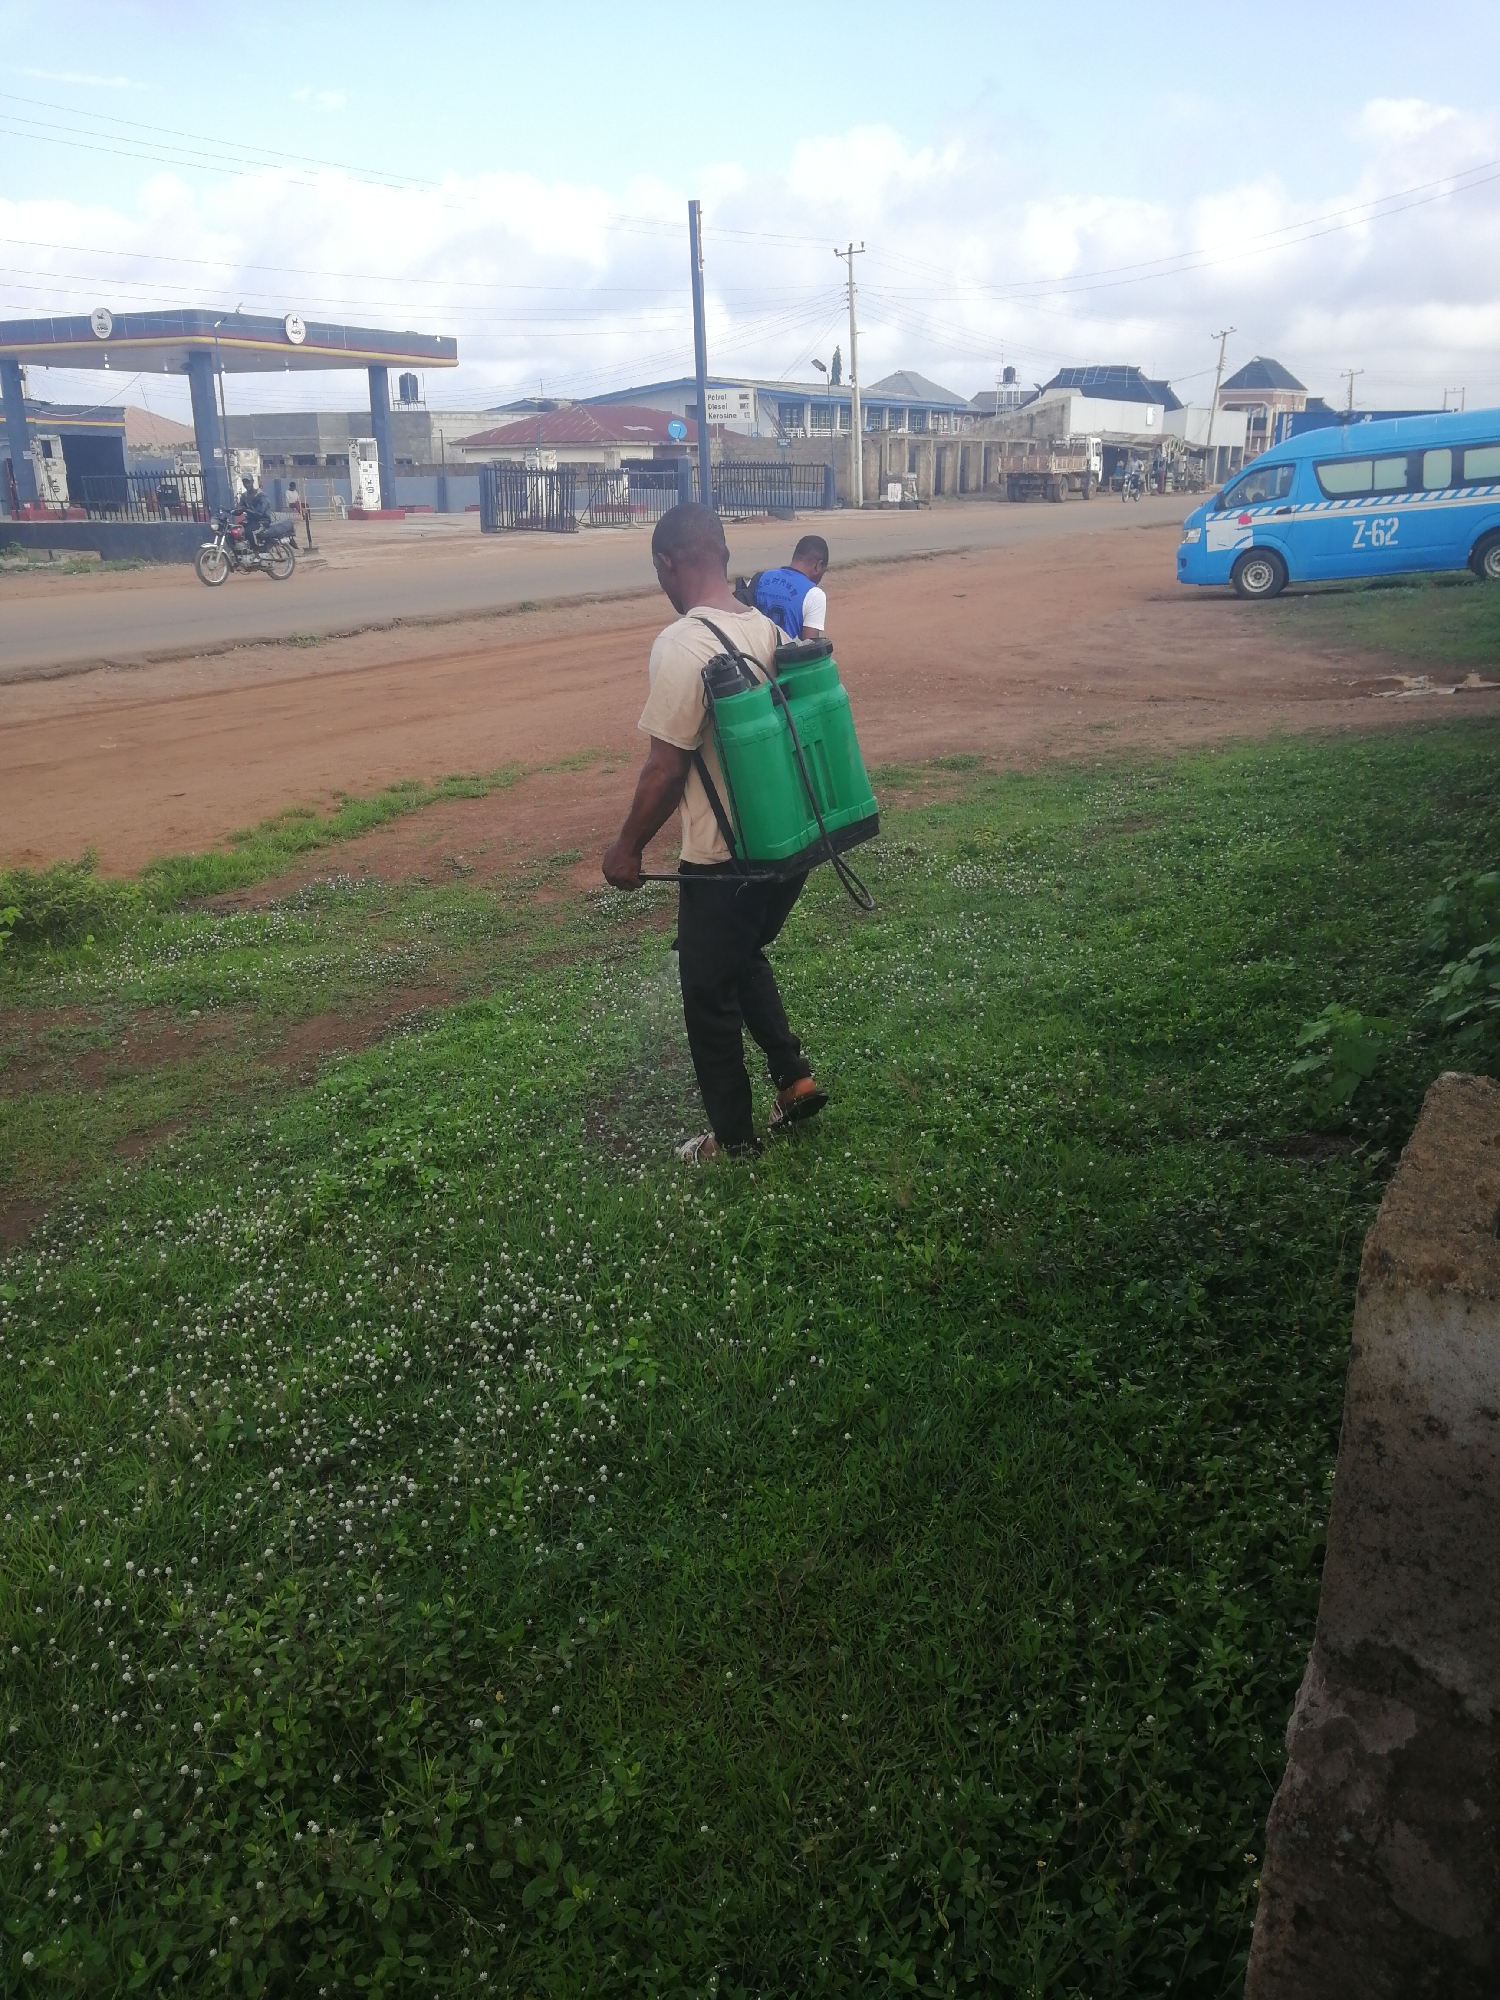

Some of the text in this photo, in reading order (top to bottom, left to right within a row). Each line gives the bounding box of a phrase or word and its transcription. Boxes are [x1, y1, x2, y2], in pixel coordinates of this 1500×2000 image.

[707, 393, 727, 401] Petrol
[707, 402, 728, 410] Diesel
[708, 412, 737, 420] Kerosine
[1352, 517, 1399, 549] Z-62
